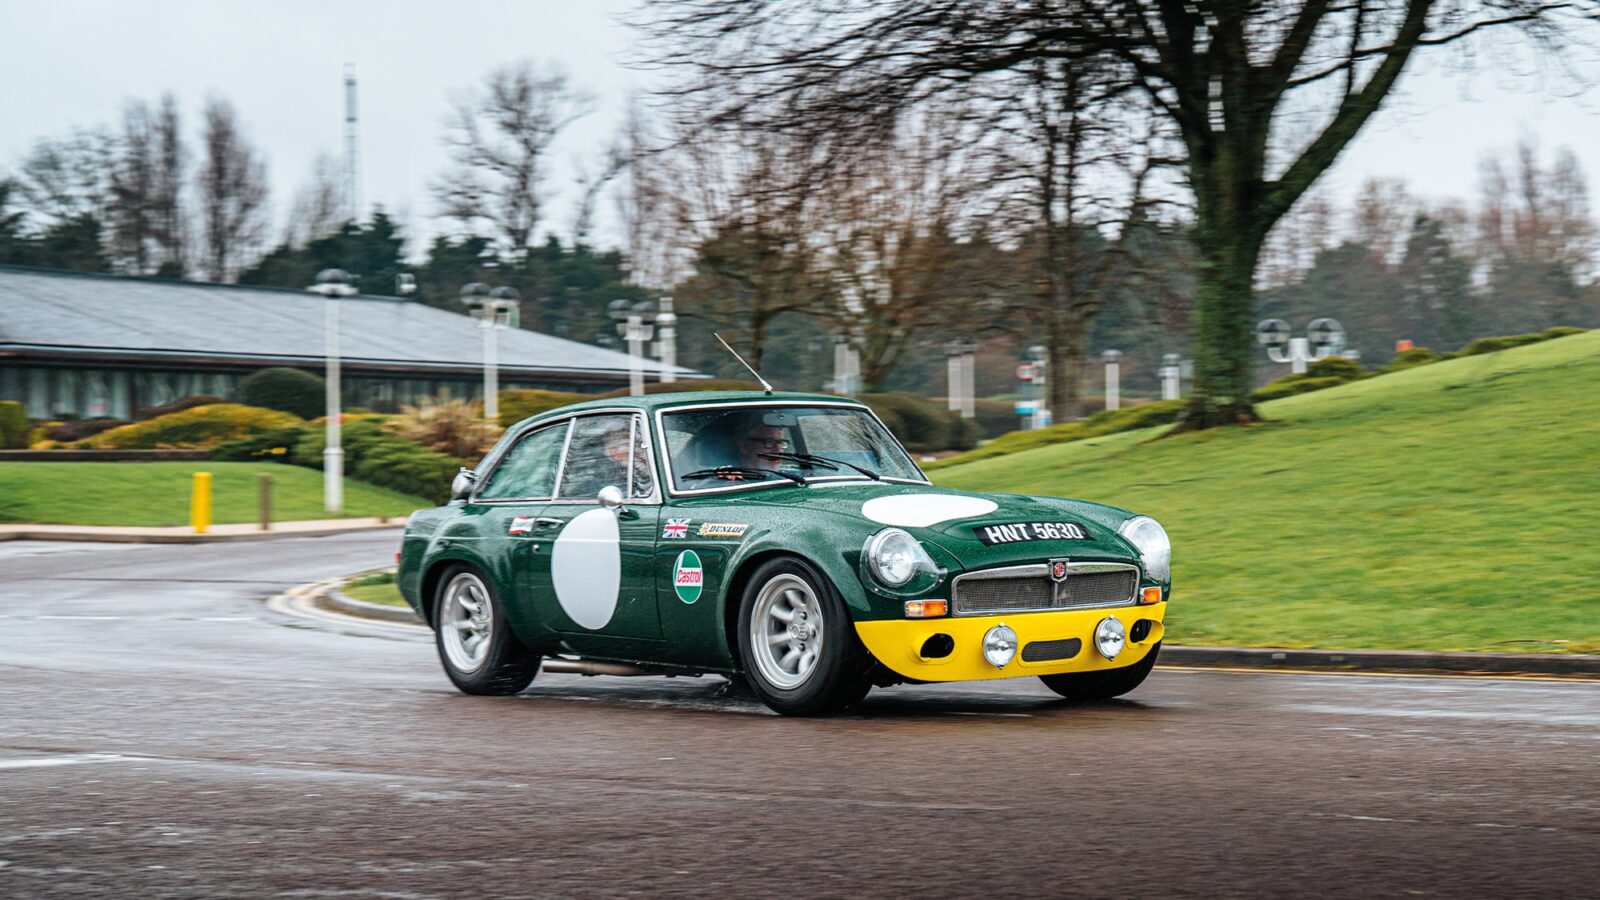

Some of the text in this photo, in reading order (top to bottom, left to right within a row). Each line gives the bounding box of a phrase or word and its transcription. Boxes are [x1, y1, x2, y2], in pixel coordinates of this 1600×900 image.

[709, 525, 745, 533] DUNLOP
[984, 523, 1084, 543] HNT 563D
[677, 569, 702, 583] Castrol
